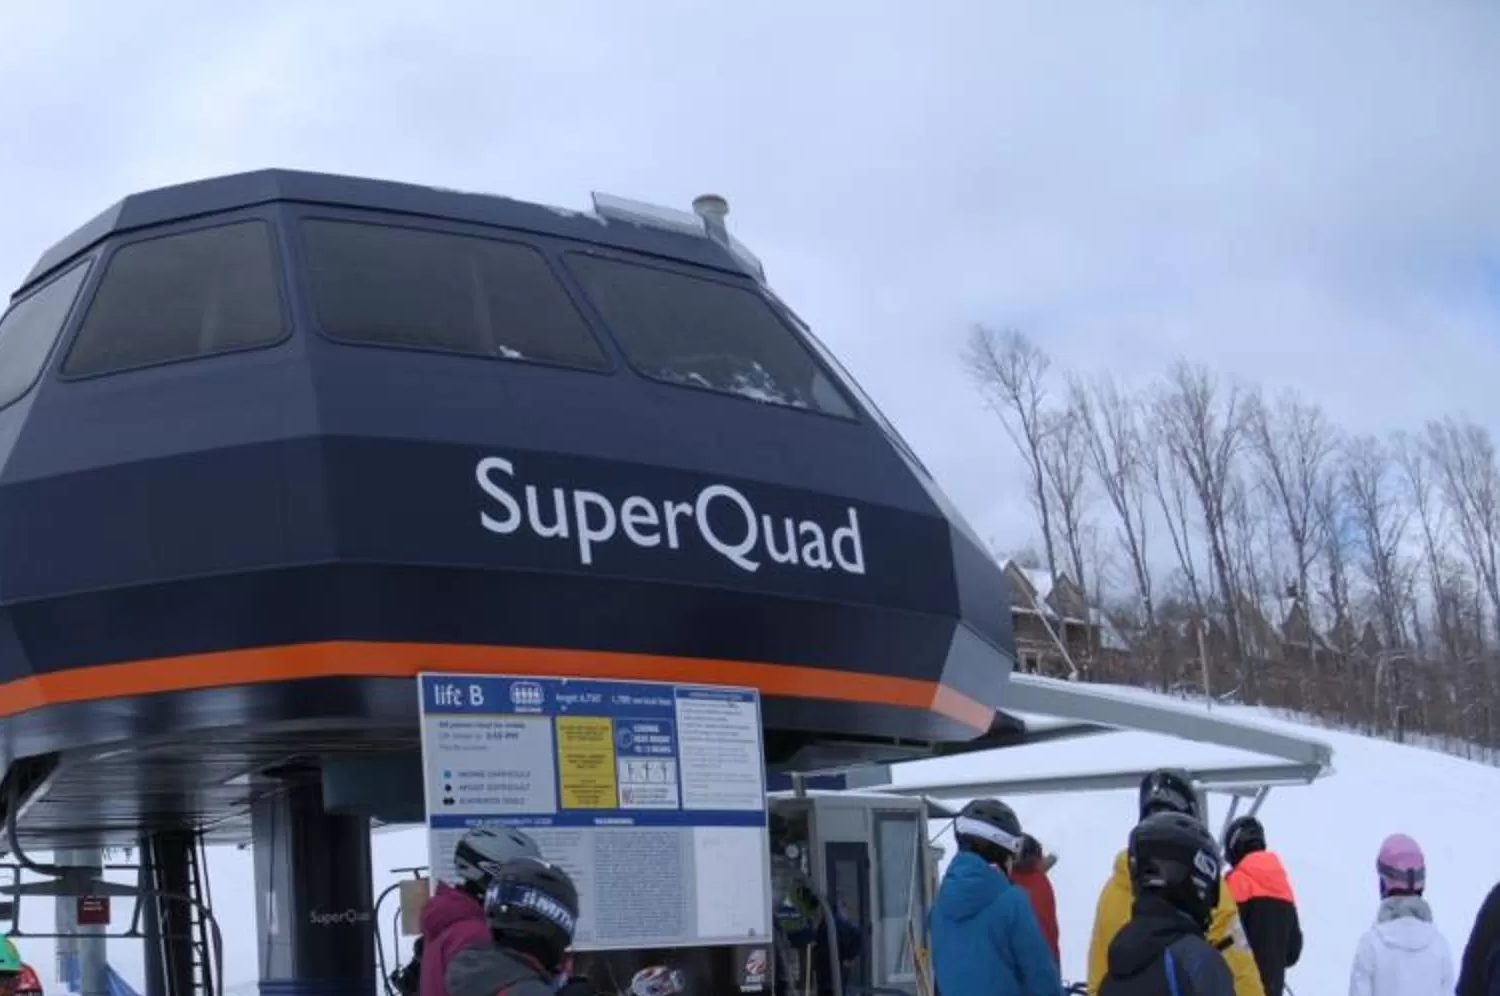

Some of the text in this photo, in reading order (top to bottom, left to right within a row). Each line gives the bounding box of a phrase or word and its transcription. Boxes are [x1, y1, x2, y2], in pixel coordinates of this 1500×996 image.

[475, 456, 865, 575] SuperQuad
[434, 684, 484, 706] lift B
